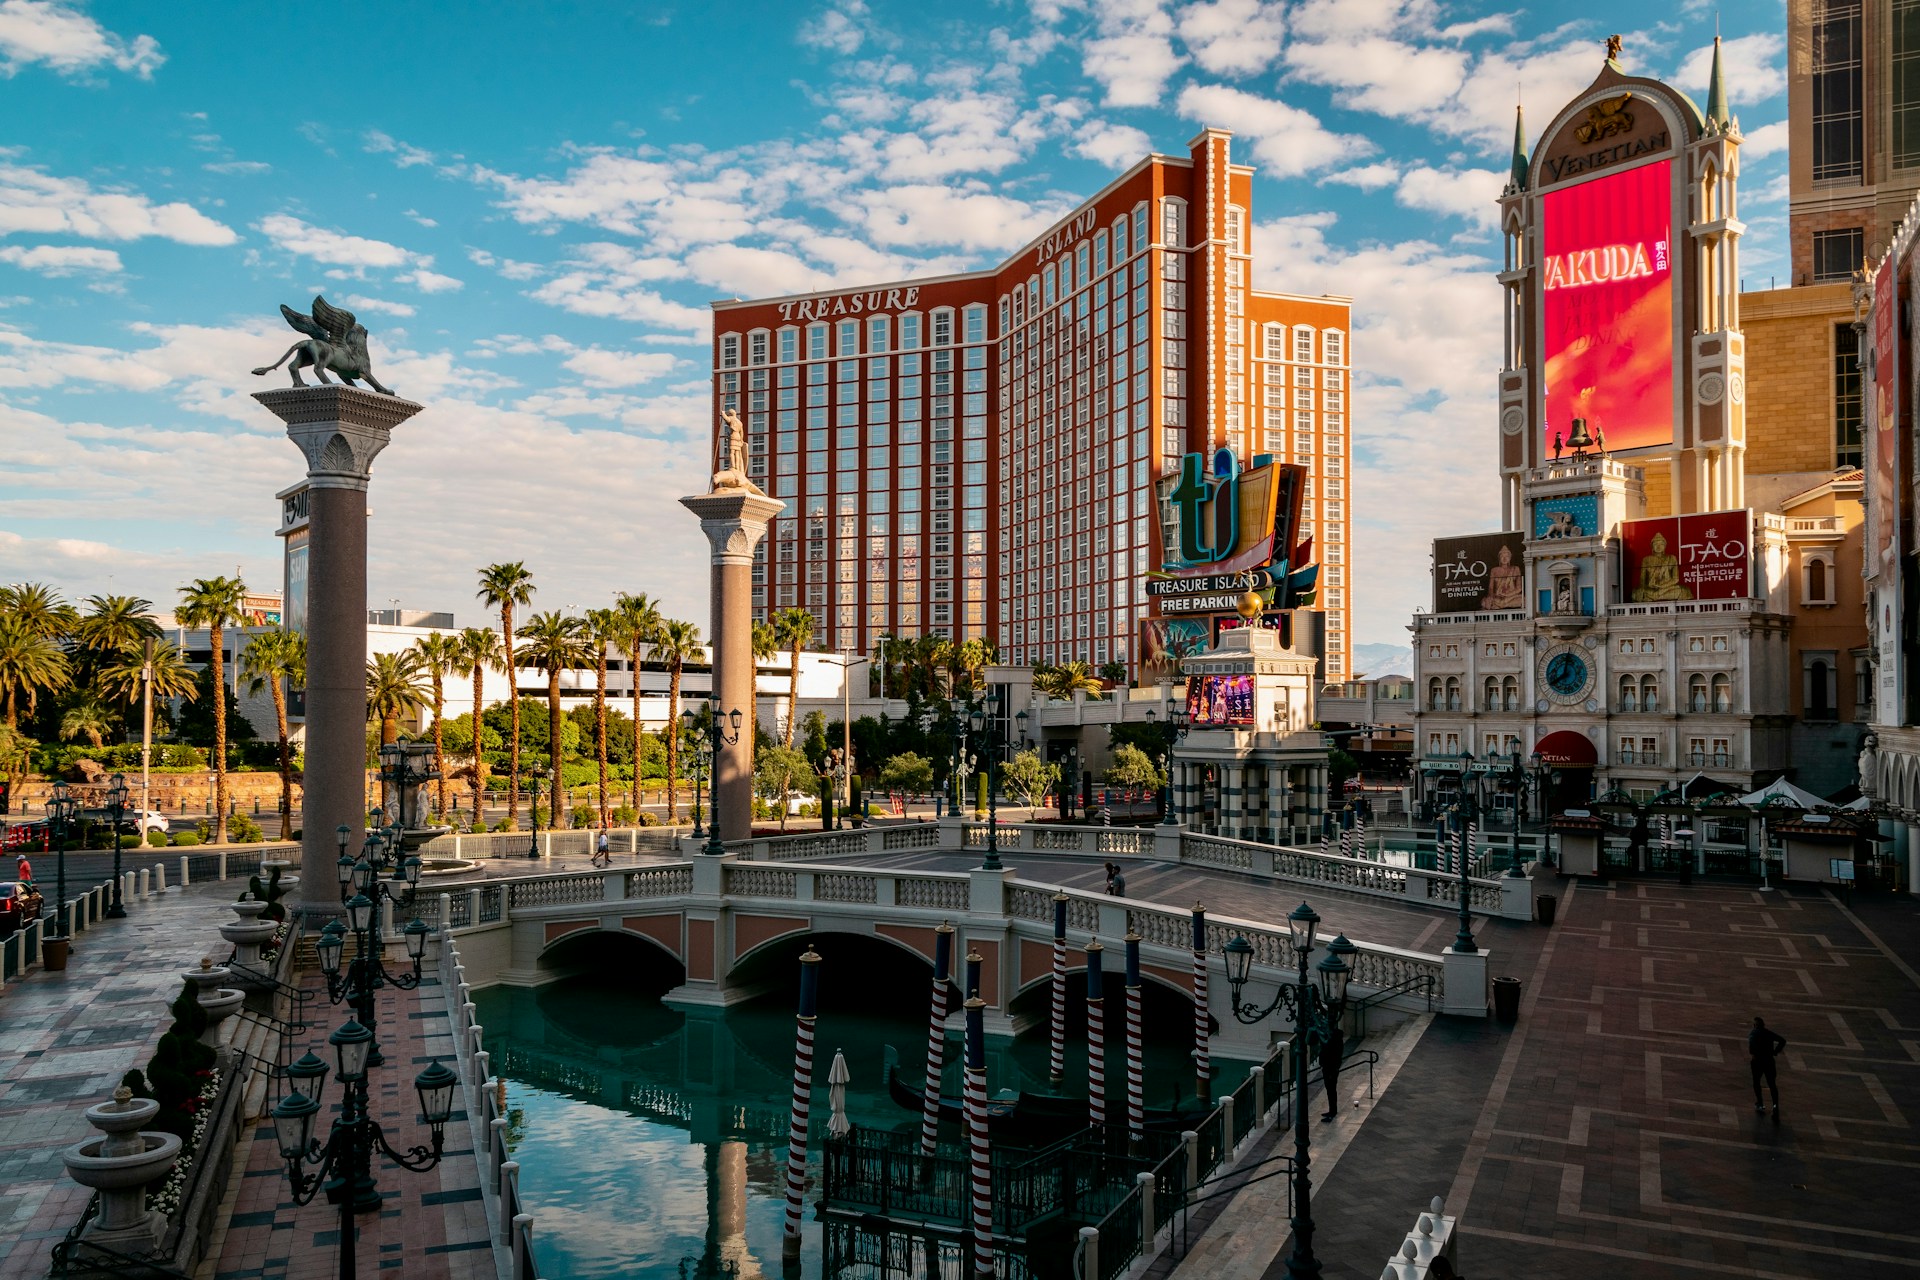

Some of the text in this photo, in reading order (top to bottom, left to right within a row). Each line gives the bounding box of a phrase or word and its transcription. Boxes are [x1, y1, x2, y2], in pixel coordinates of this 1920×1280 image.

[1543, 131, 1668, 181] VENETIAN
[777, 207, 1097, 321] TREASURE ISLAND
[1680, 540, 1745, 563] TAO
[1438, 560, 1487, 580] TAO
[1683, 568, 1743, 577] RELIGIOUS
[1684, 574, 1742, 583] NIGHTLIFE
[1153, 574, 1260, 594] TREASURE ISLAND
[1161, 595, 1238, 611] FREE PARKIN
